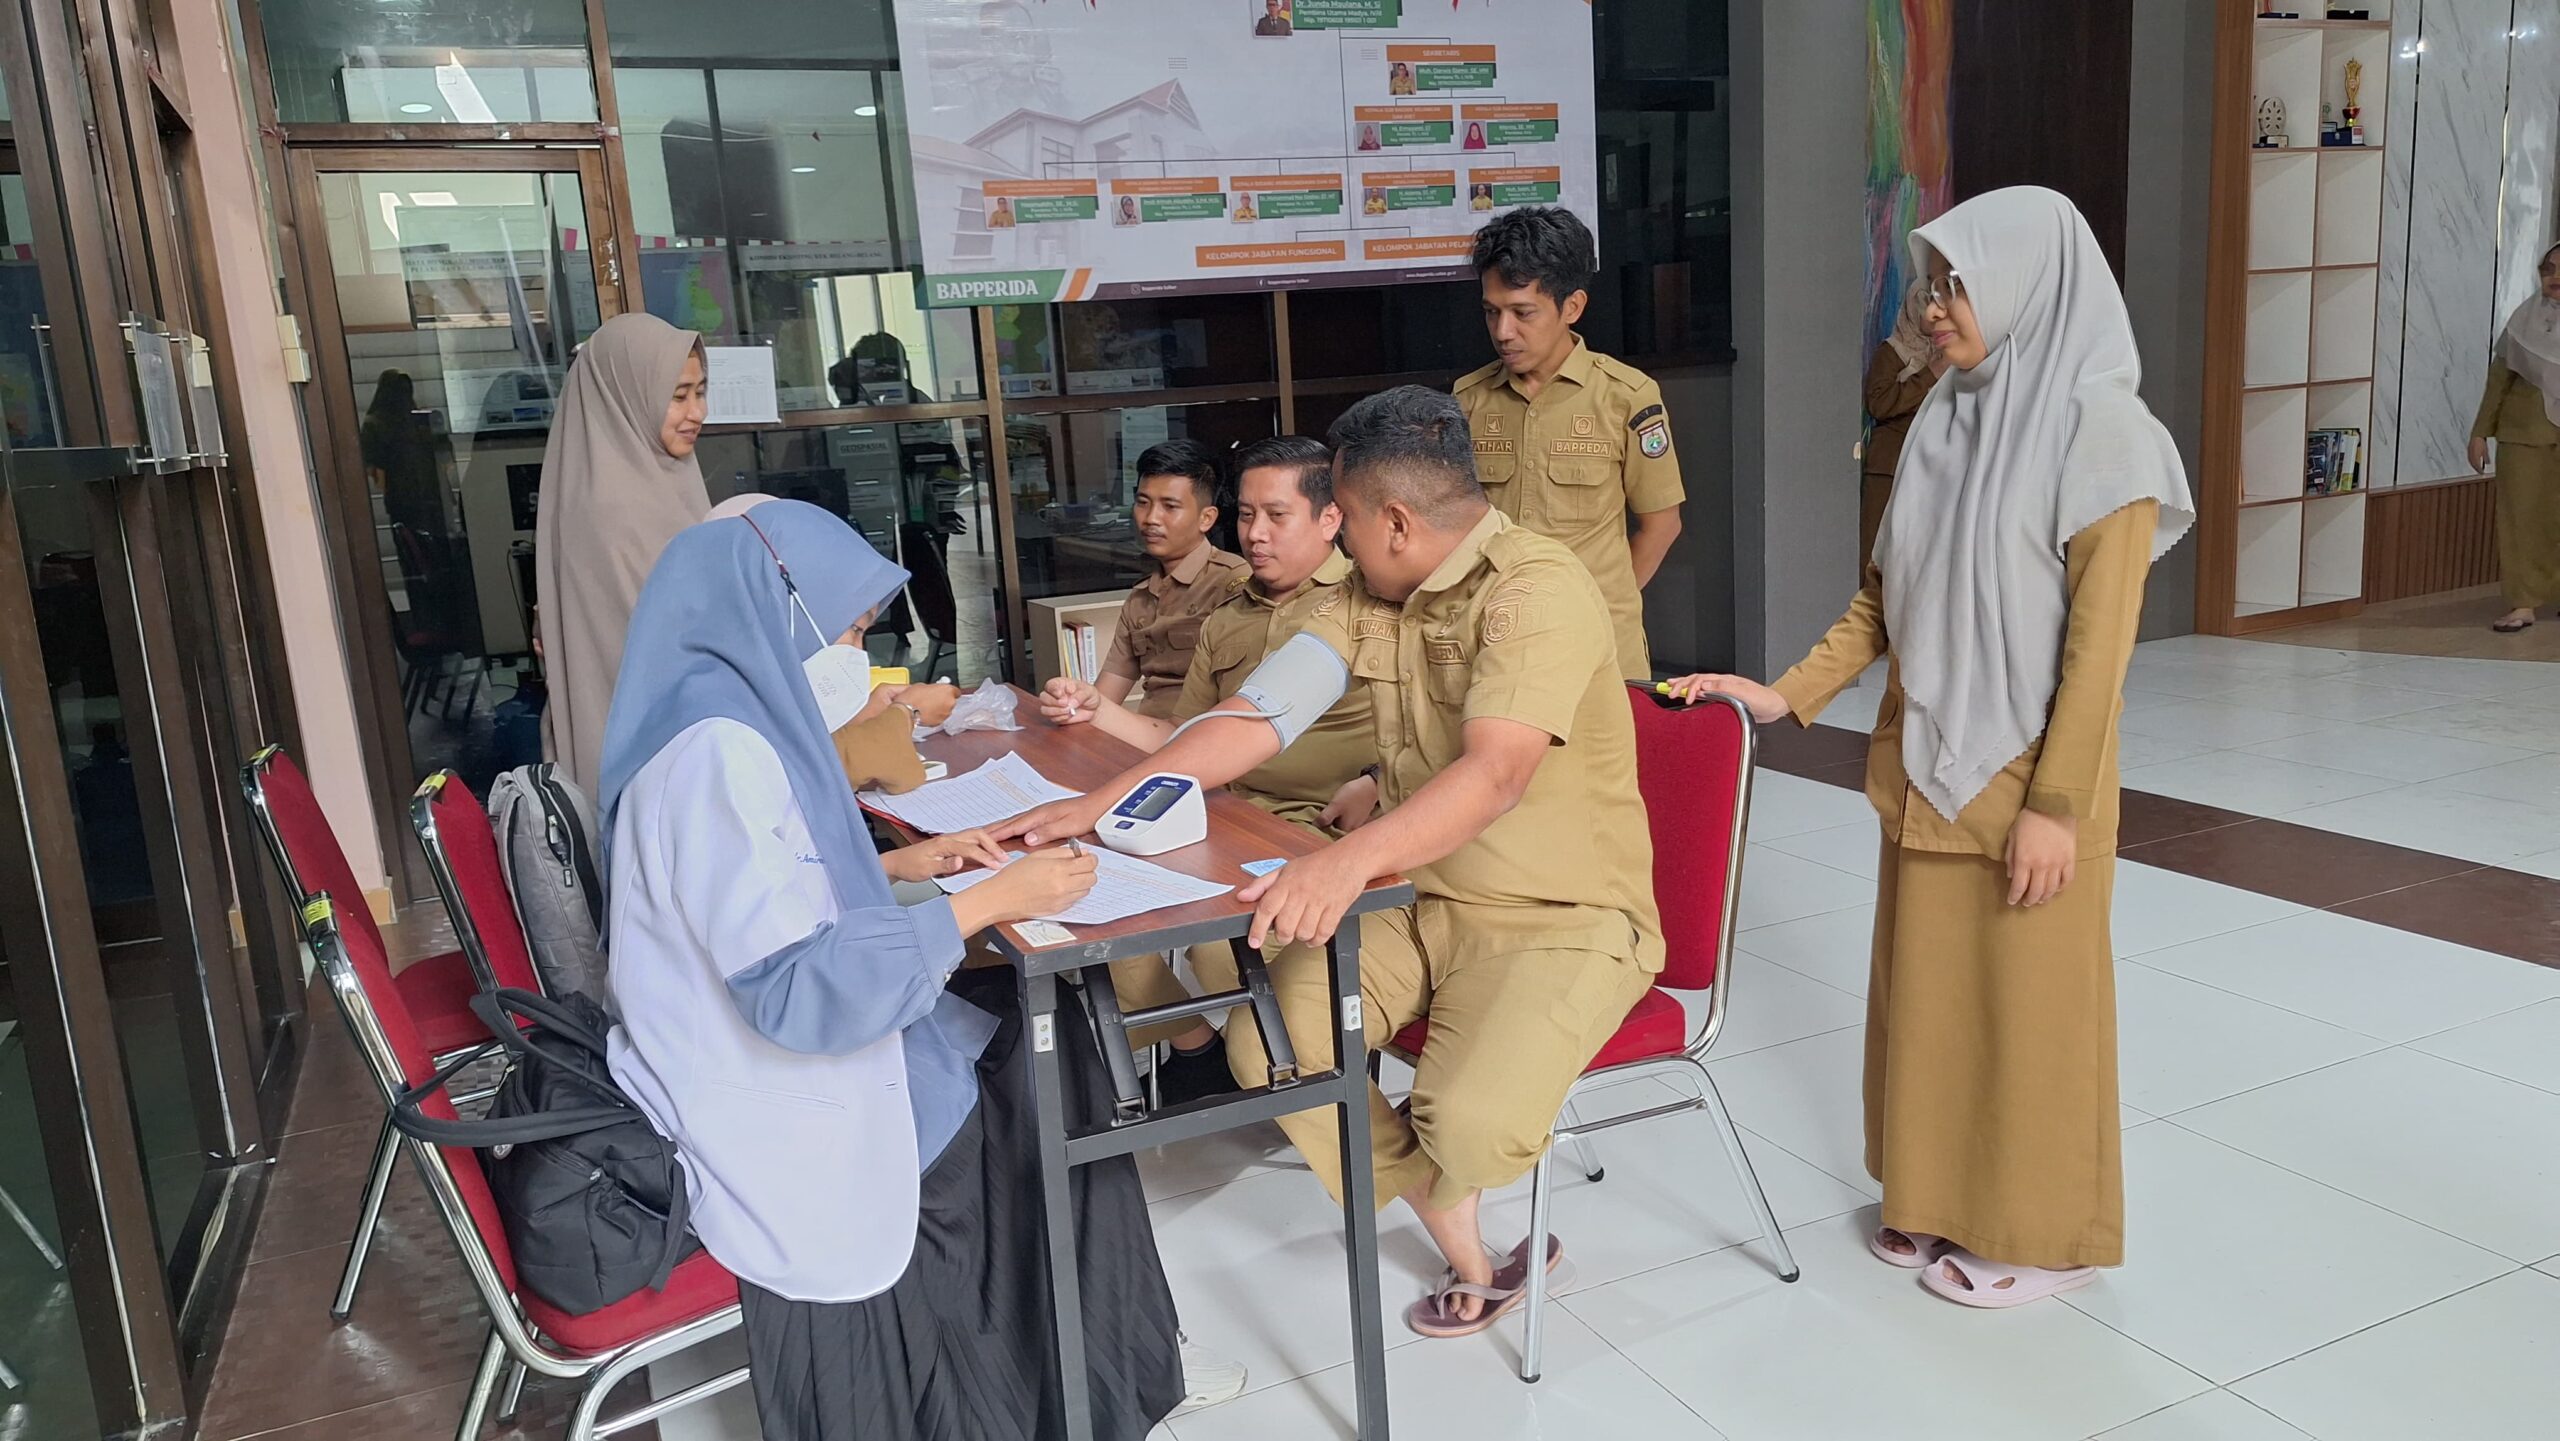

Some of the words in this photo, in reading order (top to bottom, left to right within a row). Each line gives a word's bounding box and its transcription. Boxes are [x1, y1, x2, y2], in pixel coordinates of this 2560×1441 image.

[1372, 244, 1413, 252] KELOMPOK
[1415, 241, 1447, 250] JABATAN
[1205, 252, 1249, 260] KELOMPOK
[1251, 250, 1287, 258] JABATAN
[1288, 247, 1337, 256] FUNGSIONAL
[936, 279, 1039, 299] BAPPERIDA
[1473, 440, 1513, 452] ATHAR
[1556, 441, 1609, 455] BAPPEDA
